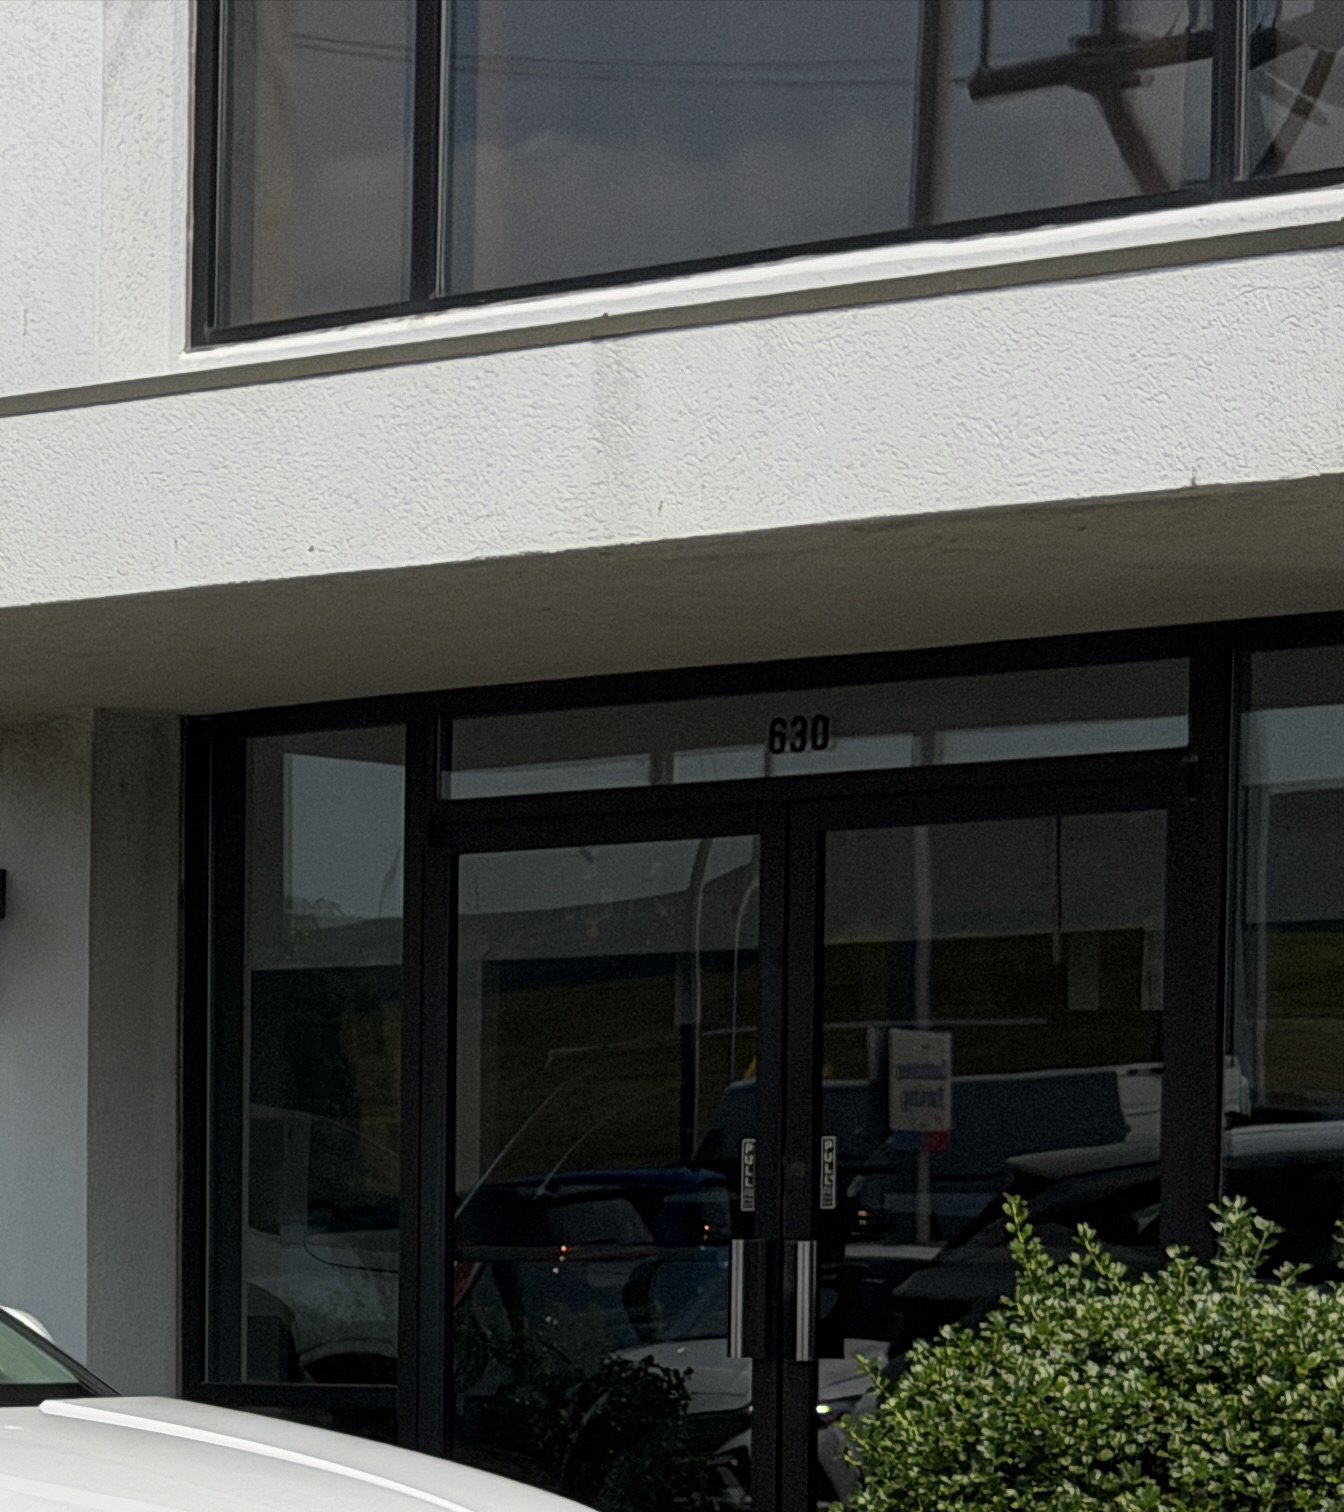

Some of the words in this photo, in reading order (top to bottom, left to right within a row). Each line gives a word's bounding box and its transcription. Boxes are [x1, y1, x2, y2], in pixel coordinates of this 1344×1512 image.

[768, 713, 830, 754] 630
[744, 1142, 755, 1188] PULL
[824, 1140, 833, 1186] PULL
